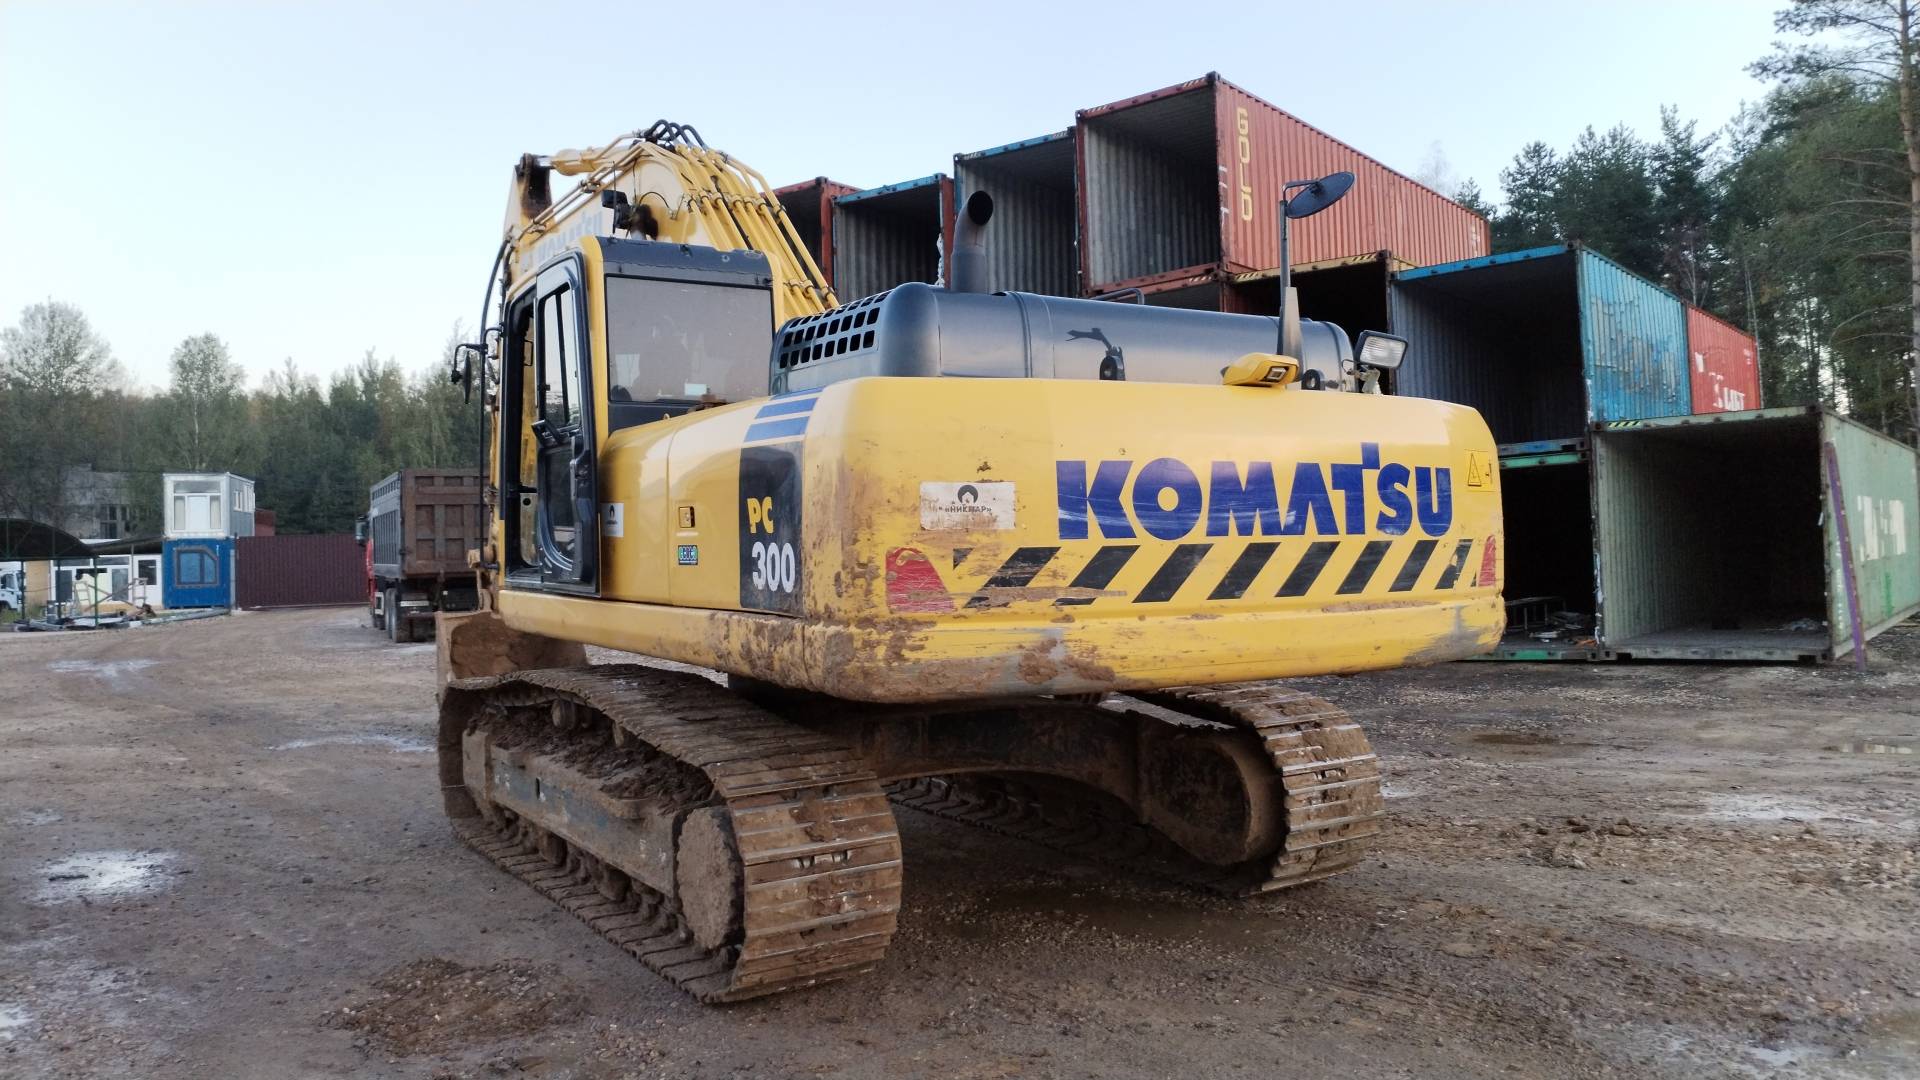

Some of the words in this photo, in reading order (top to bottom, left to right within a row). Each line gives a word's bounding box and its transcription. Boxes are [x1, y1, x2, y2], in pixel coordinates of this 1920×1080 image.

[1237, 107, 1253, 221] GOLD
[748, 497, 774, 534] PC
[1056, 441, 1453, 540] KOMATSU
[752, 541, 795, 593] 300
